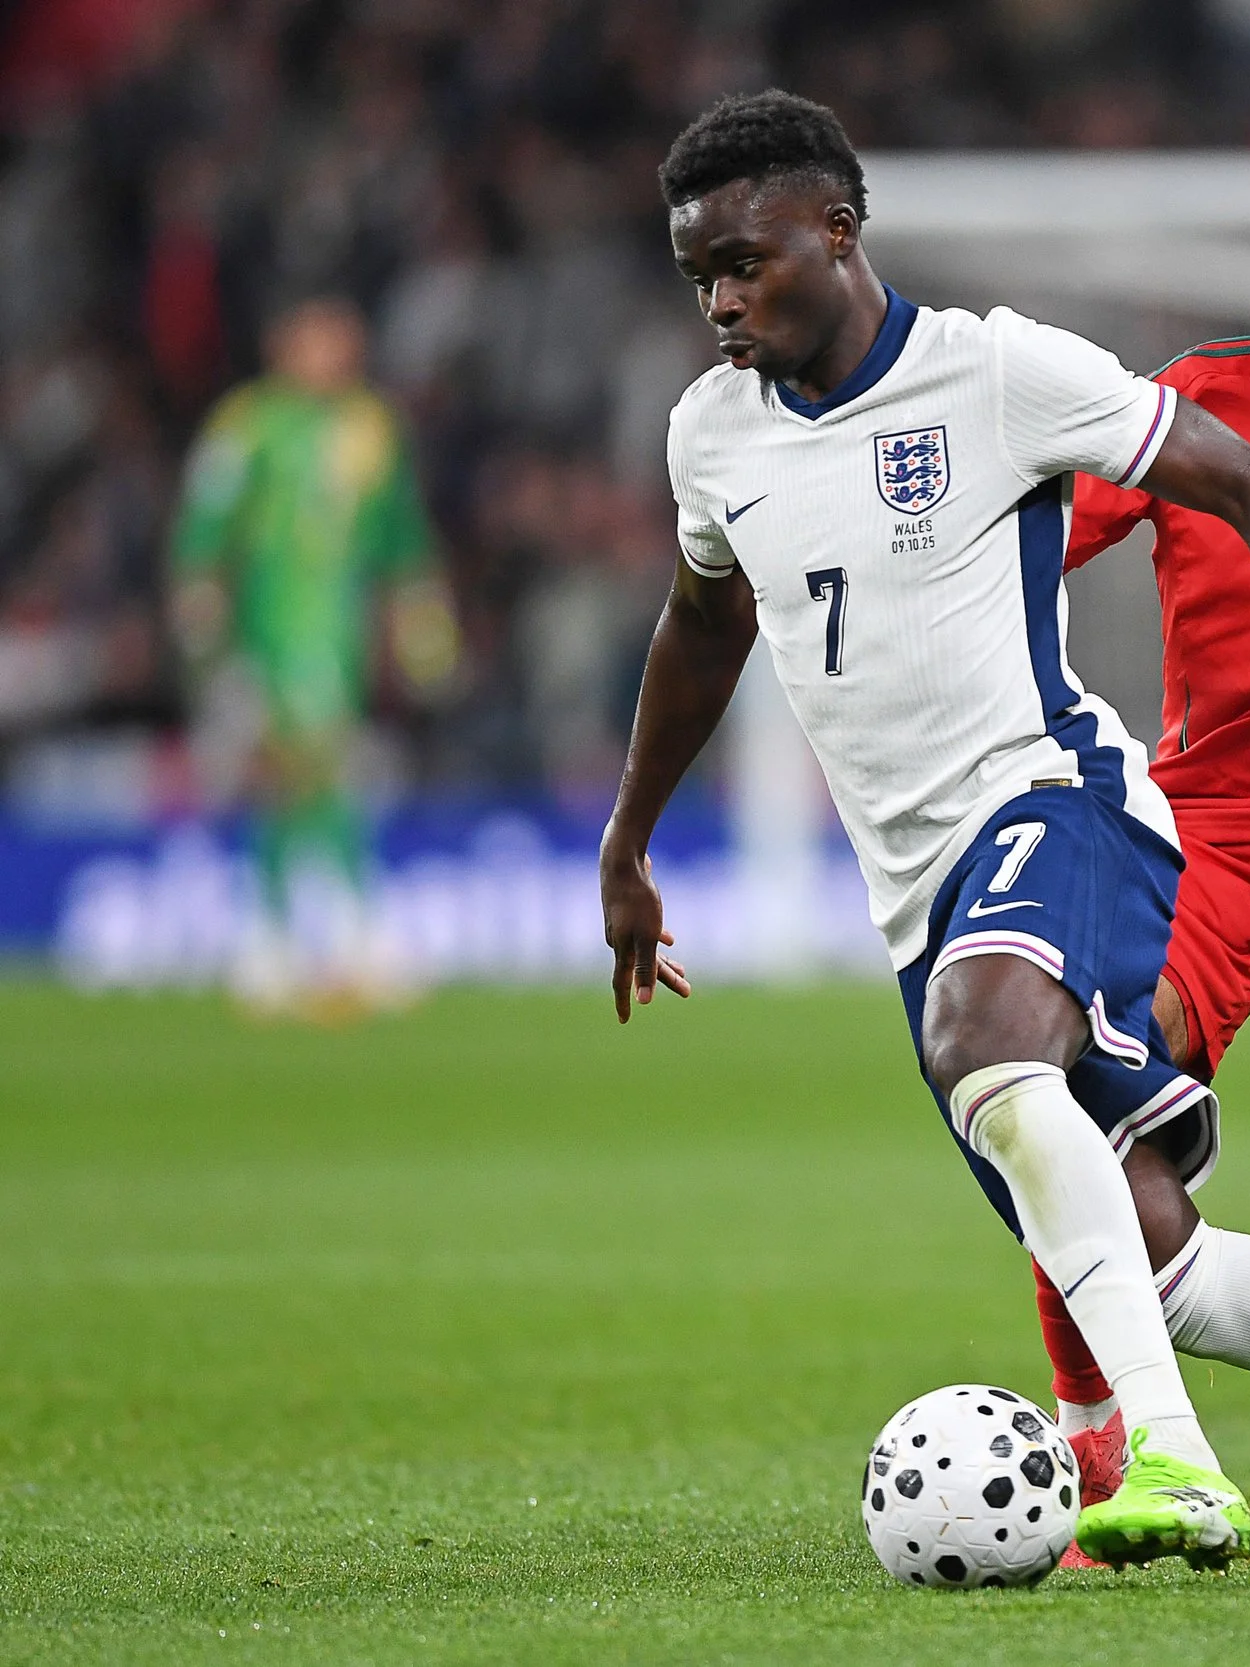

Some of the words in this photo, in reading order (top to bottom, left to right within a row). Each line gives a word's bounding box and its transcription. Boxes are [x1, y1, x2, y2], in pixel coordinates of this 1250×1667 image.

[891, 536, 935, 554] 09.10.25
[894, 519, 933, 537] WALES
[805, 566, 848, 677] 7
[987, 821, 1047, 894] 7
